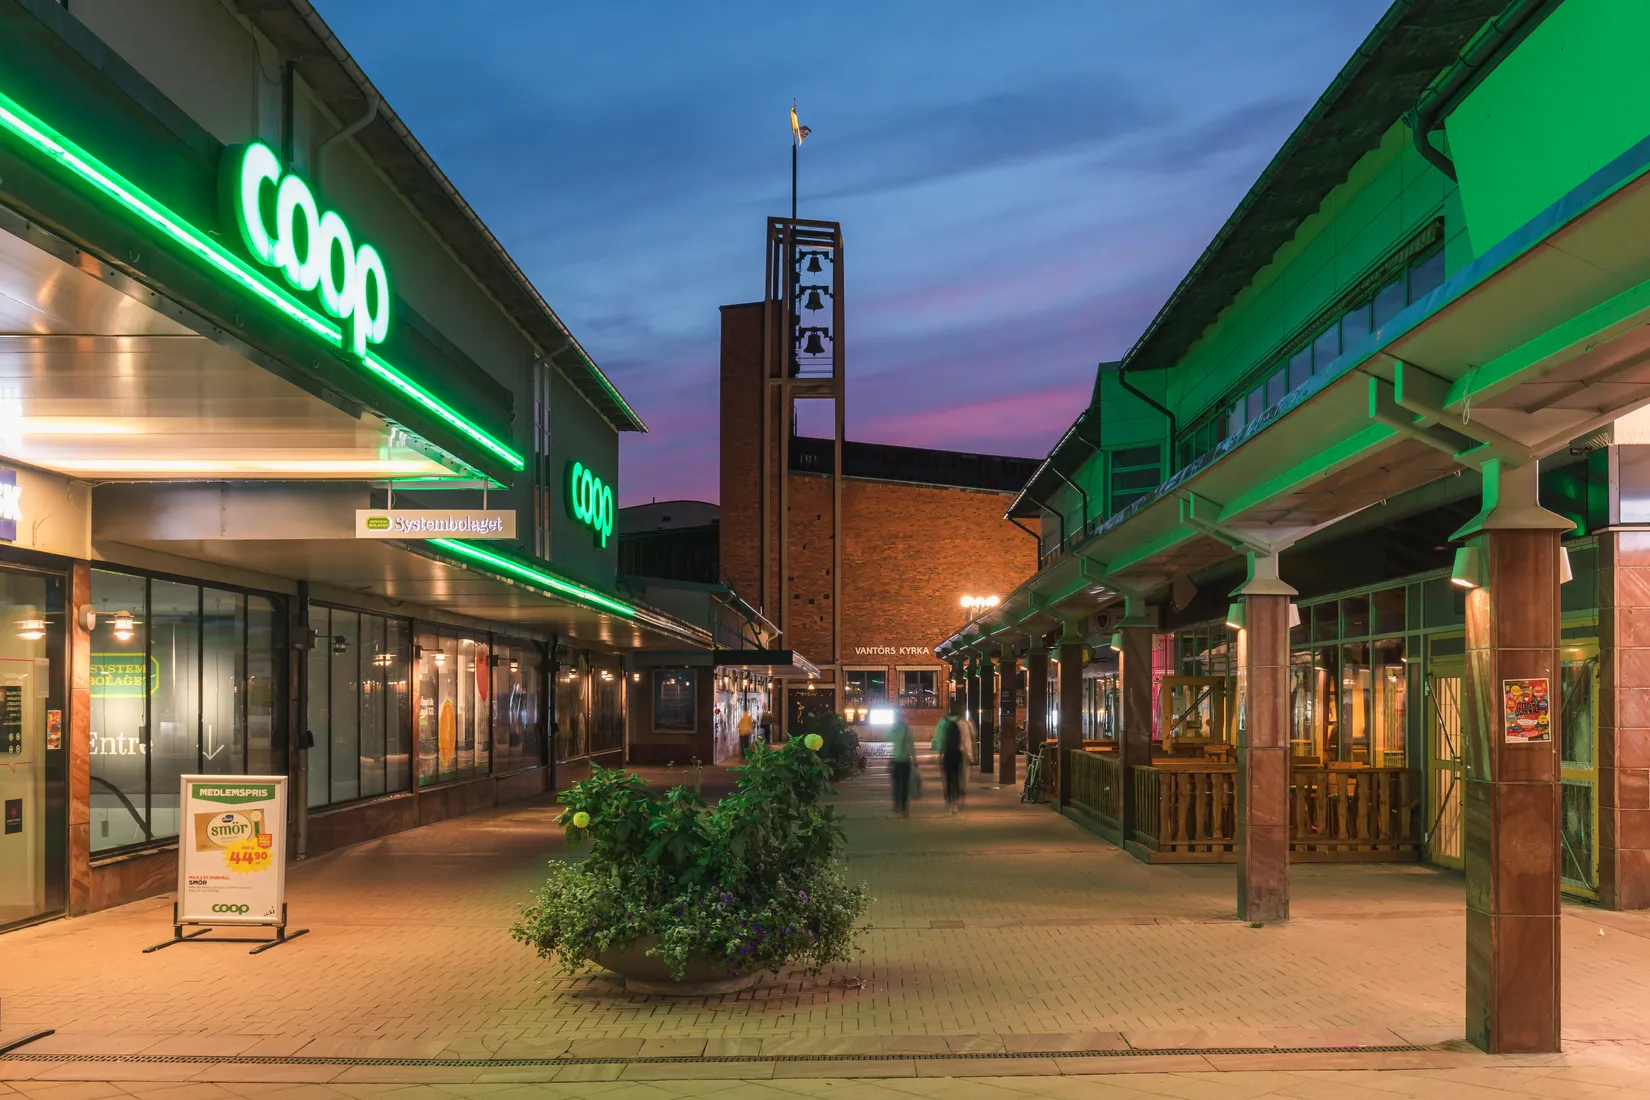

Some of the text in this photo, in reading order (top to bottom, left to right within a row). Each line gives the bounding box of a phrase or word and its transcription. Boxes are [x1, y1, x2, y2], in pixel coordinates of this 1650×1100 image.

[240, 141, 390, 360] coop
[572, 461, 613, 549] coop
[395, 516, 503, 534] Systembolaget
[854, 644, 930, 654] VANTÖRS KYRKA
[200, 788, 268, 798] MEDLEMSPRIS
[211, 821, 248, 836] smör
[212, 904, 250, 915] coop
